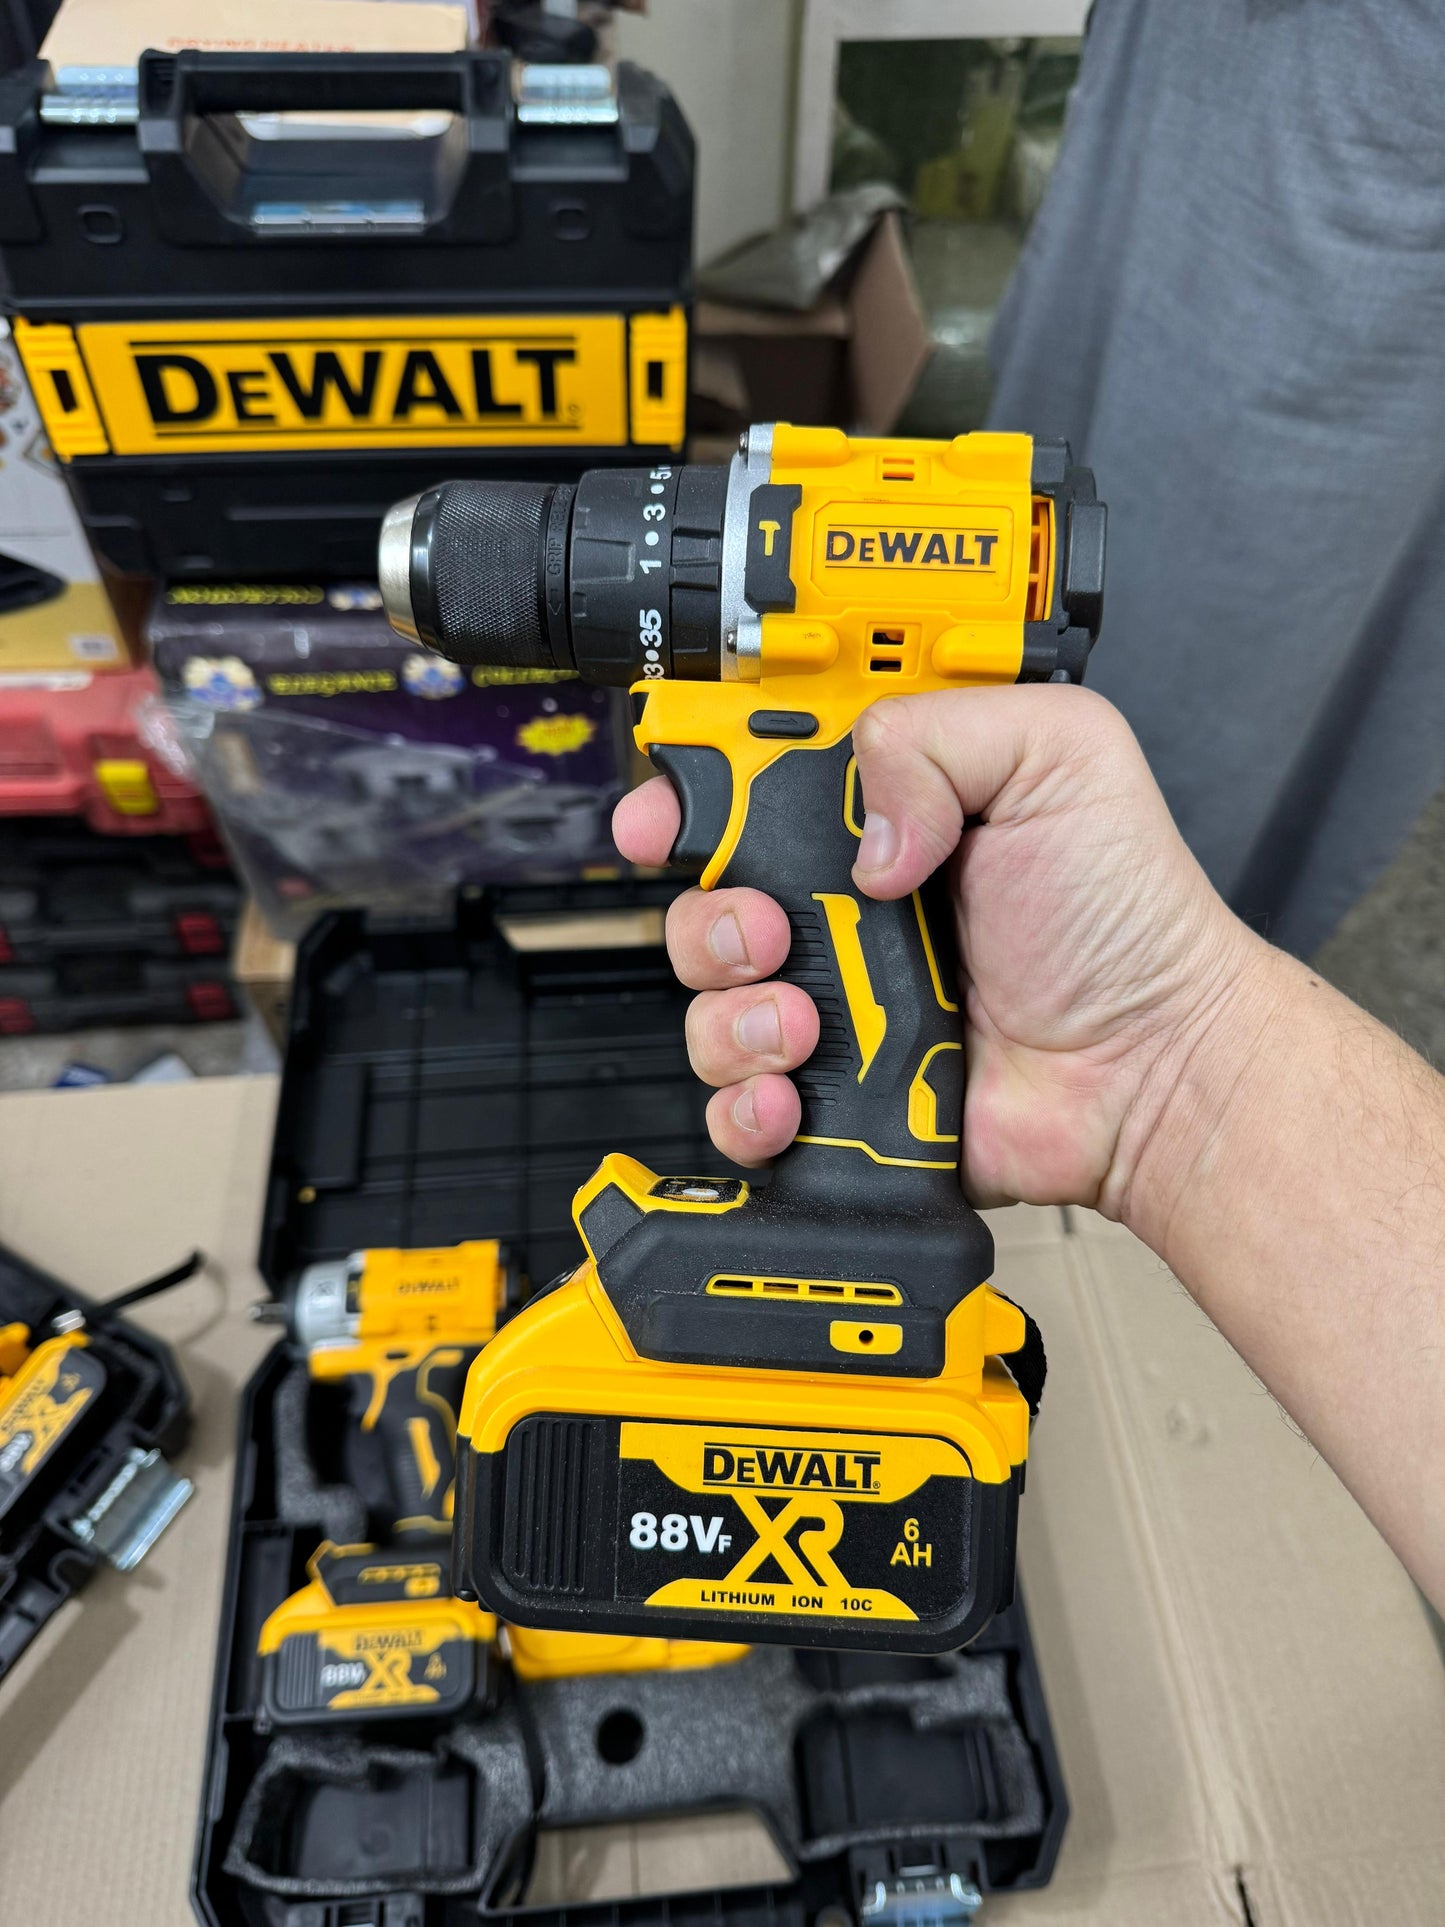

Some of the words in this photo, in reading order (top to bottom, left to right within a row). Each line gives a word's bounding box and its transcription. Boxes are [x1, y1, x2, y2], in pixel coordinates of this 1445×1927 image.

[134, 348, 576, 425] DEWALT
[643, 503, 666, 521] 3
[826, 531, 998, 566] DEWALT
[639, 559, 662, 574] 1
[639, 609, 662, 648] 35
[722, 1494, 852, 1588] XR
[903, 1517, 920, 1542] 6
[890, 1541, 932, 1567] AH
[700, 1590, 775, 1607] LITHIUM
[791, 1595, 824, 1609] ION
[840, 1598, 873, 1611] 10C
